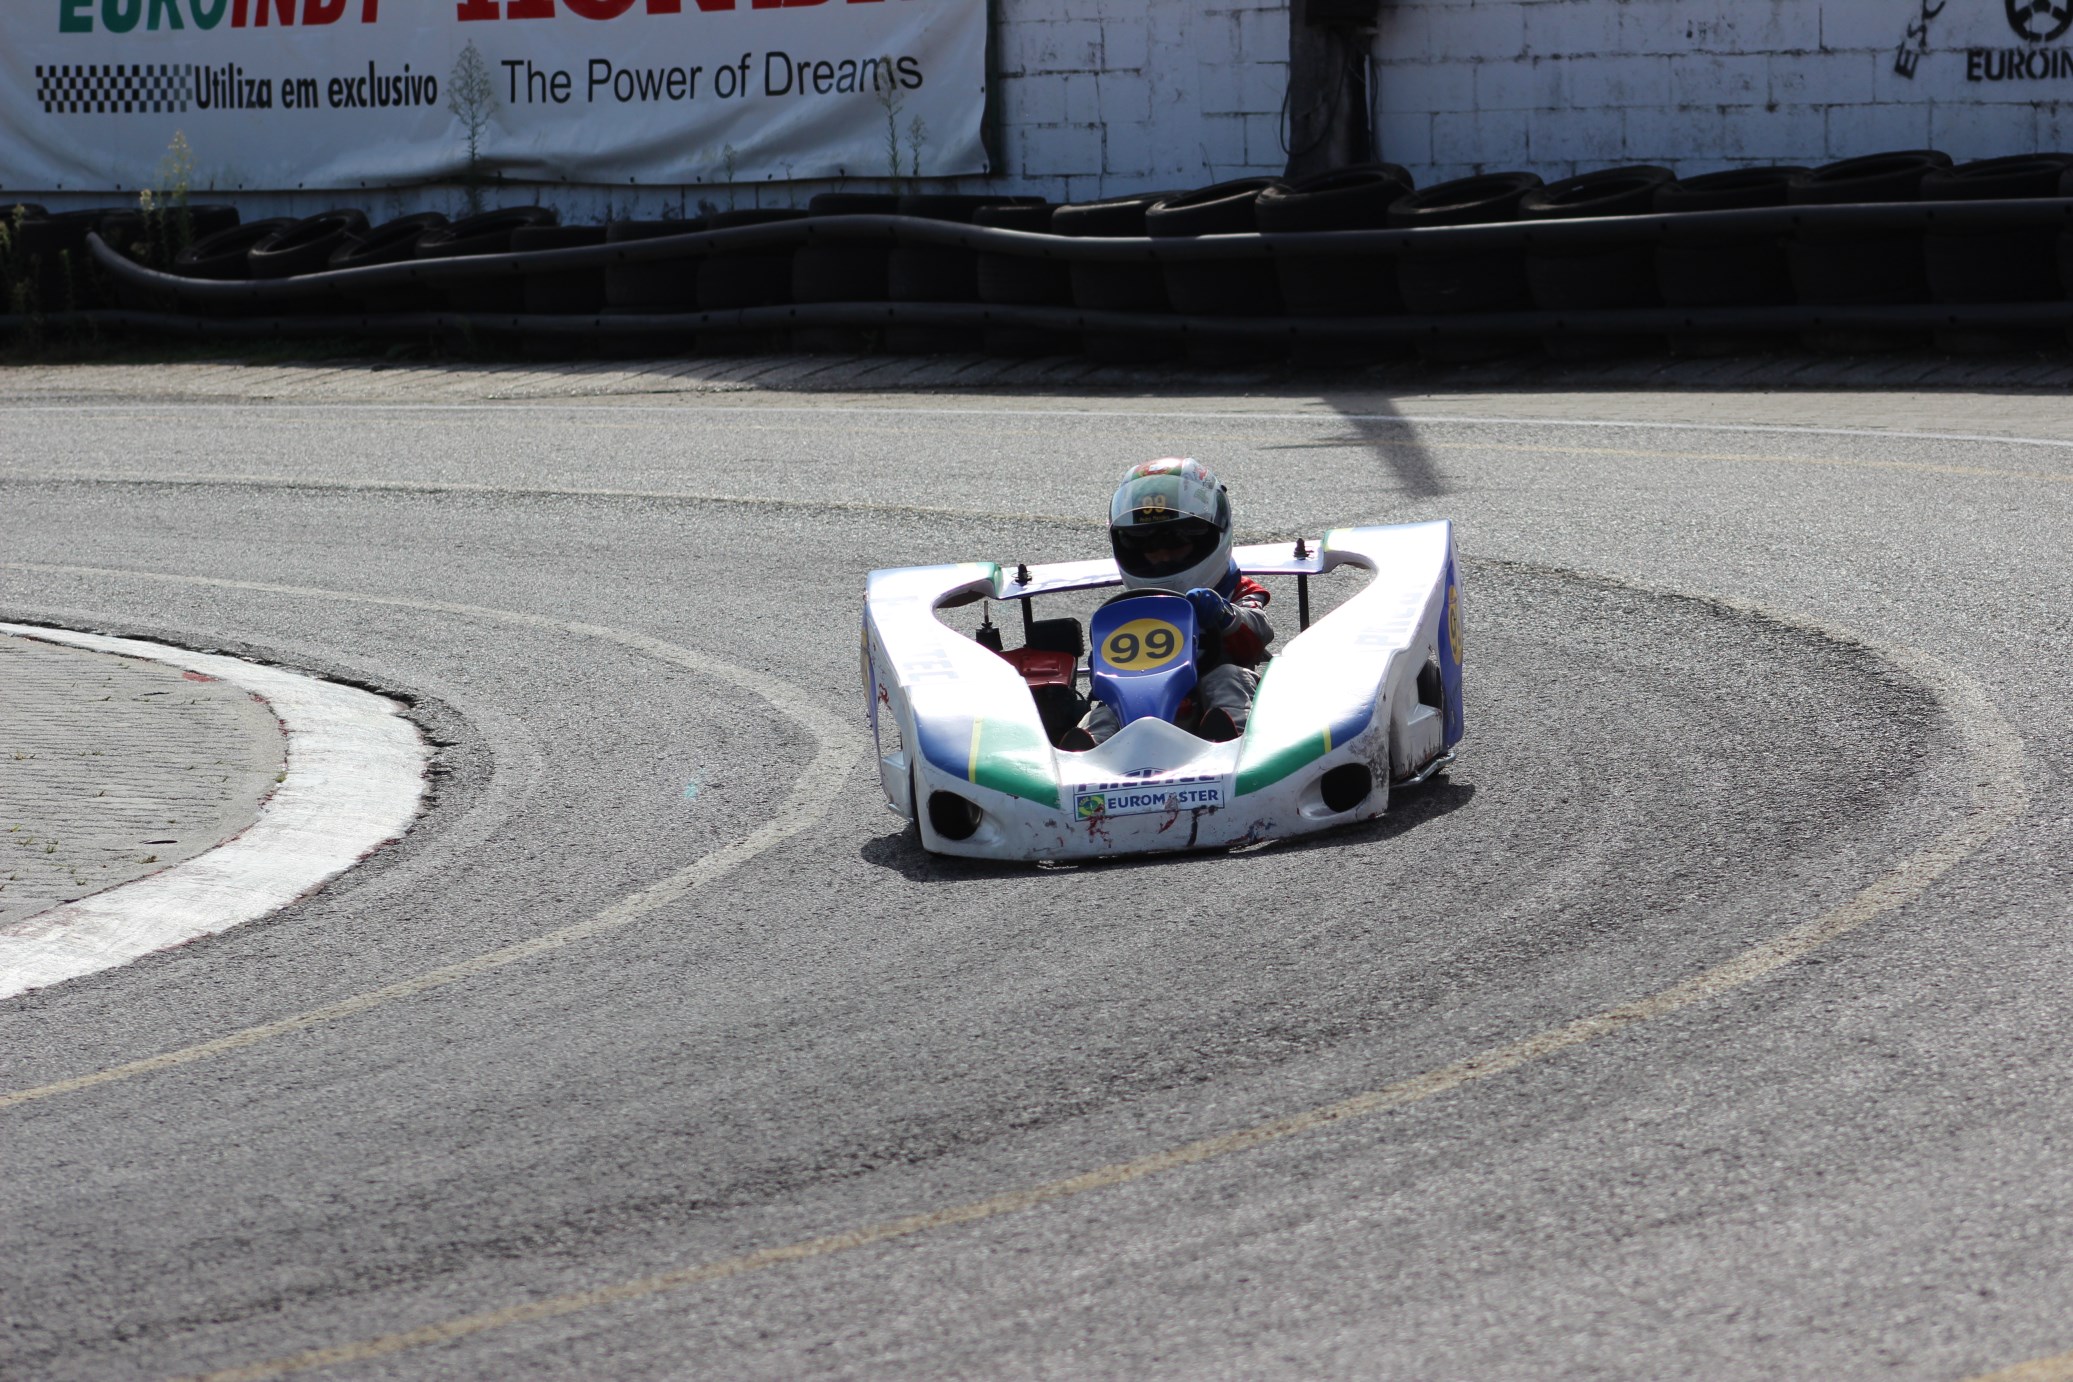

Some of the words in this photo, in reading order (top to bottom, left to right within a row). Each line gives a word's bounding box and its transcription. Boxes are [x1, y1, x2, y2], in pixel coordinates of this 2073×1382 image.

[194, 62, 272, 110] Utiliza
[281, 77, 319, 110] em
[327, 60, 438, 108] exclusivo
[501, 59, 572, 104] The
[587, 58, 704, 103] Power
[714, 52, 752, 99] of
[764, 50, 923, 97] Dreams
[1109, 628, 1175, 664] 99
[1107, 788, 1218, 810] EUROMSTER
